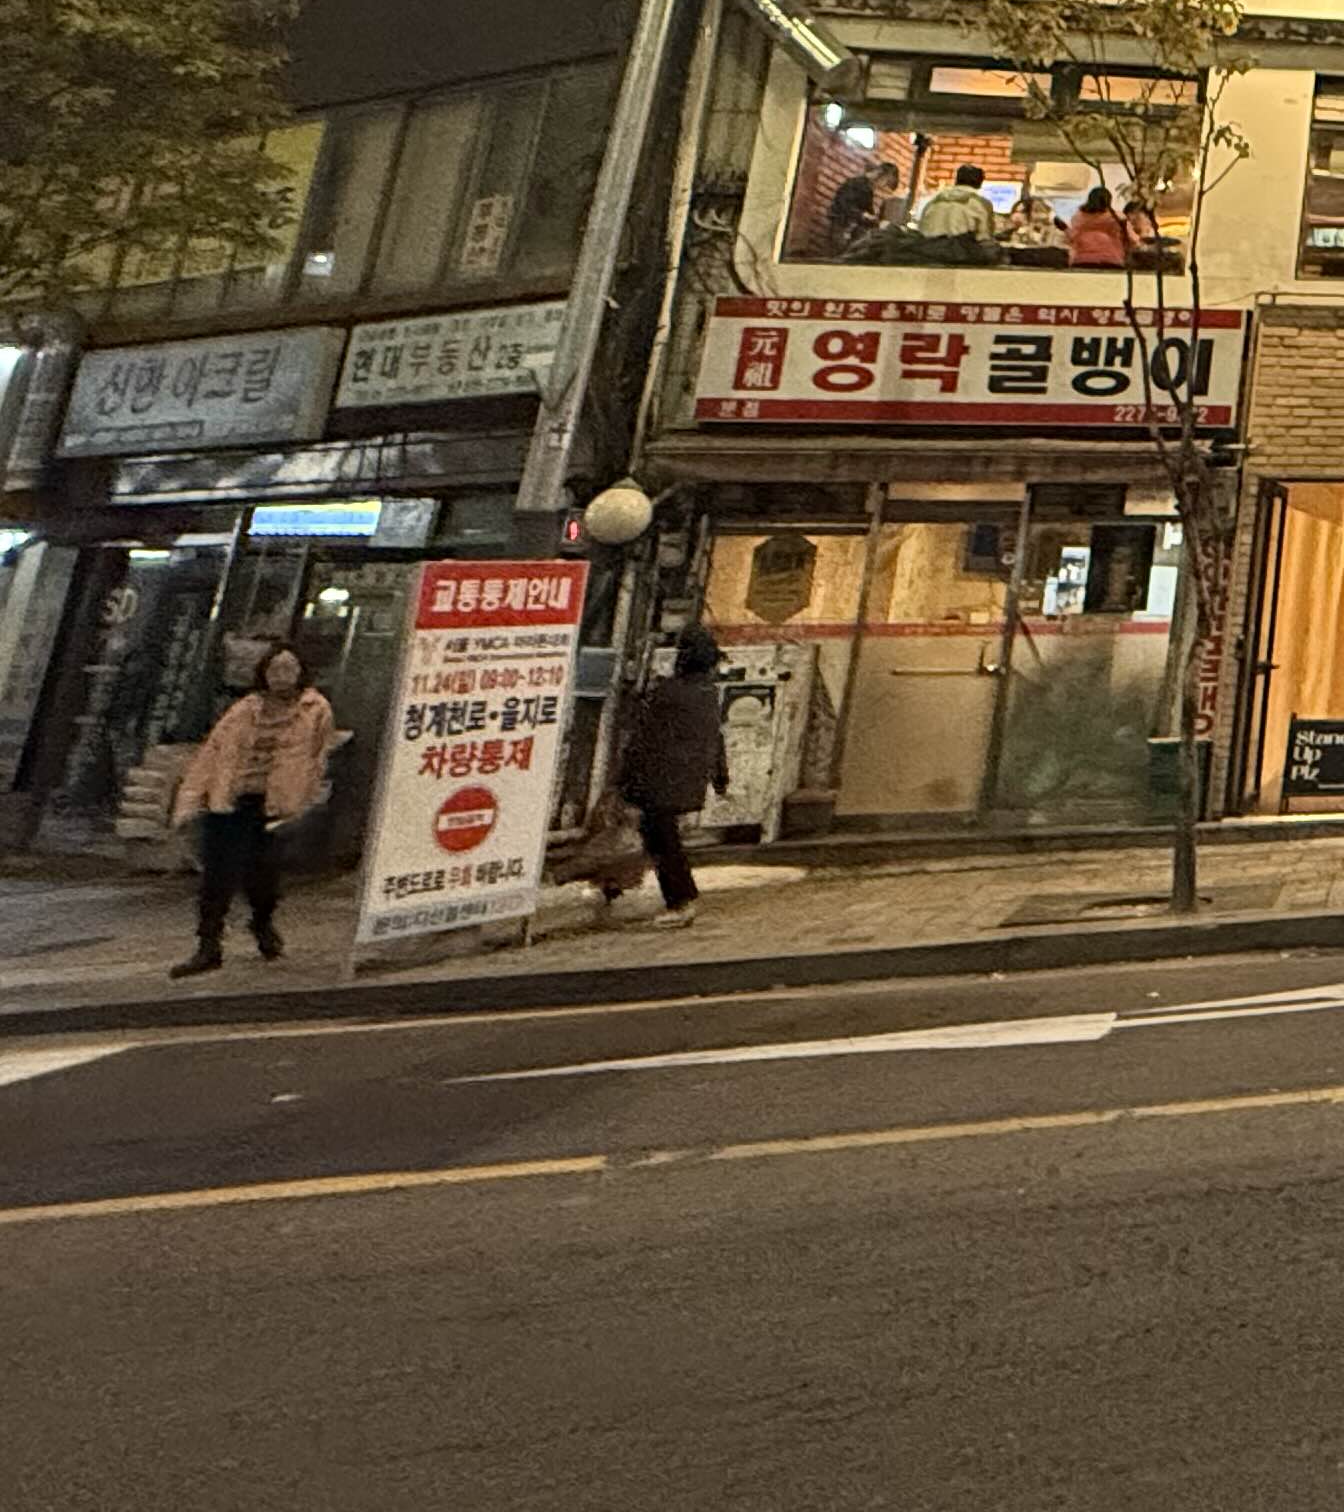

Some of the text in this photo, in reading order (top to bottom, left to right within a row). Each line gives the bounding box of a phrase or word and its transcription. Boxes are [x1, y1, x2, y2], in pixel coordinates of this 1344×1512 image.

[743, 330, 778, 388] 元祖
[431, 576, 573, 613] 교통통제안내
[417, 735, 535, 780] 차량통제
[1292, 745, 1322, 765] Up
